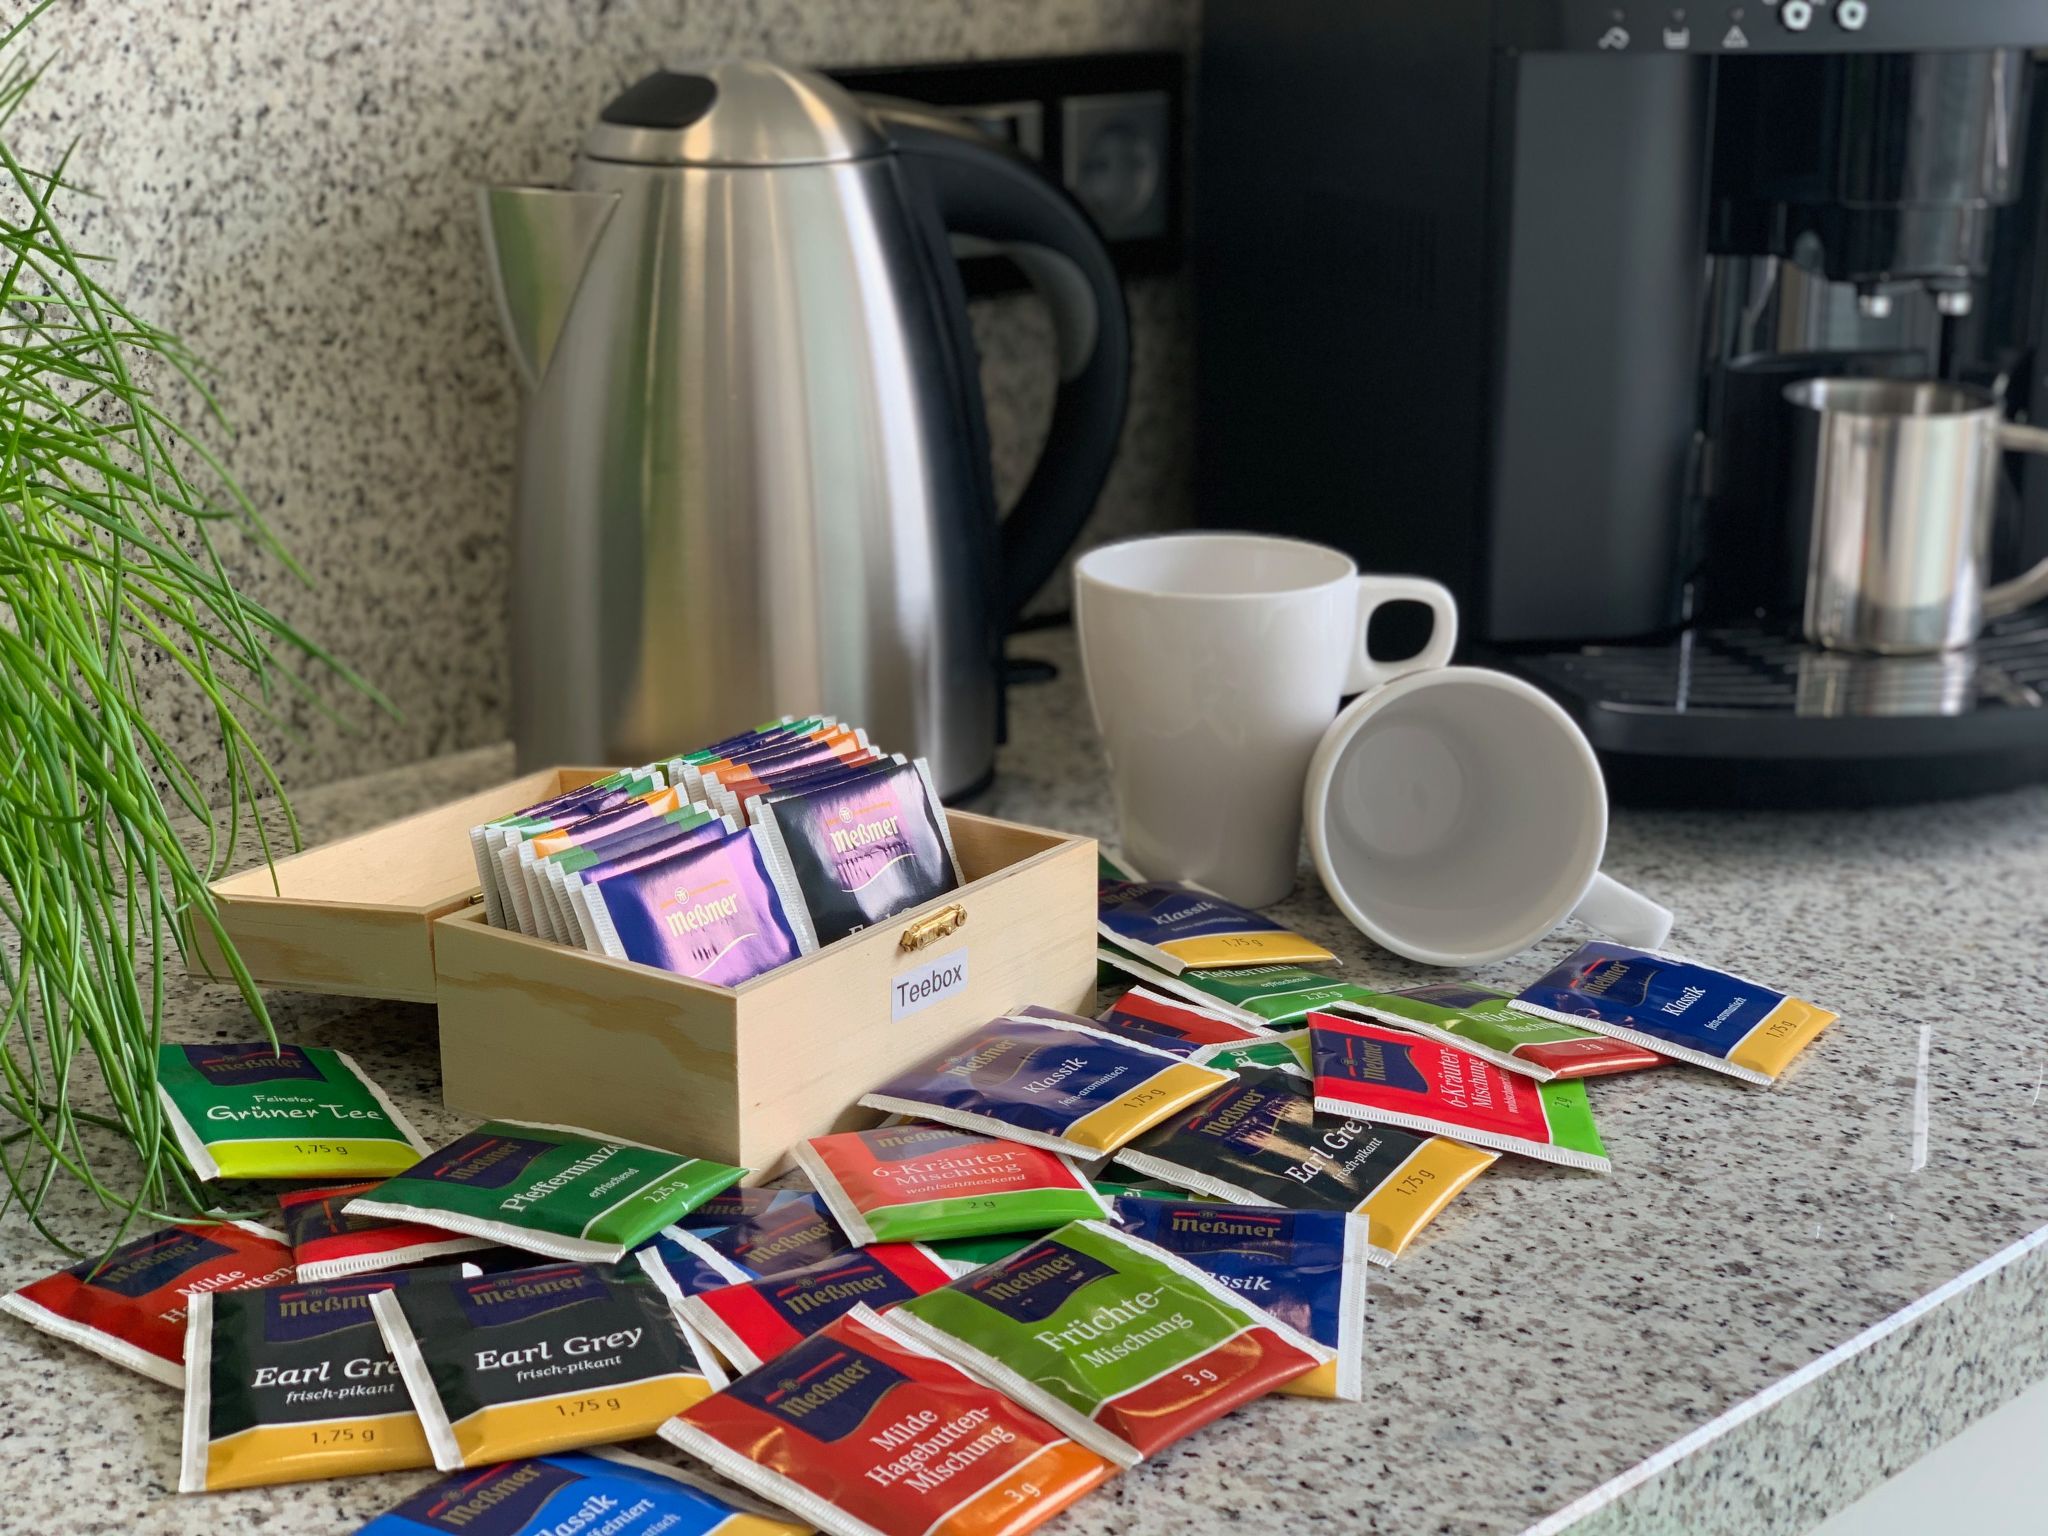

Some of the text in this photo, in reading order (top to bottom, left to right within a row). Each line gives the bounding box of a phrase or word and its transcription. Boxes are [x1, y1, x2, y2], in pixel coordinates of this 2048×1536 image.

[829, 815, 900, 854] Meßmer
[666, 891, 740, 938] Meßmer
[1152, 901, 1218, 926] Klassik
[1222, 937, 1264, 948] 1,75 g
[896, 963, 964, 1008] Teebox
[1582, 960, 1631, 996] Meßmer
[1301, 989, 1344, 1001] 2,25 g
[1661, 985, 1707, 1017] Klassik
[1703, 996, 1748, 1031] fein-aromatisch
[1766, 1020, 1799, 1040] 1,75 g
[208, 1055, 303, 1074] Meßmer
[948, 1038, 1018, 1077] Meßmer
[1363, 1040, 1387, 1082] Meßmer
[1022, 1056, 1088, 1094] Klassik
[1057, 1065, 1129, 1107] fein-aromatisch
[1439, 1047, 1469, 1109] 6-Kräuter-
[1467, 1057, 1494, 1110] Mischung
[206, 1103, 383, 1122] Grüner Tee
[252, 1094, 315, 1104] Feinster
[1123, 1088, 1168, 1111] 1,75 g
[1200, 1087, 1266, 1138] Meßmer
[294, 1144, 348, 1156] 1,75 g
[449, 1141, 523, 1181] Meßmer
[871, 1151, 1028, 1178] 6-Kräuter-
[1284, 1145, 1334, 1184] Earl
[1334, 1137, 1383, 1184] frisch-pikant
[500, 1143, 628, 1213] Pfefferminze
[588, 1167, 640, 1199] erfrischend
[895, 1163, 1023, 1186] Mischung
[905, 1174, 1027, 1195] wohlschmeckend
[1397, 1168, 1437, 1196] 1,75 g
[647, 1180, 689, 1204] 2,25 g
[967, 1200, 997, 1209] 2 g
[747, 1221, 836, 1265] Meßmer
[1172, 1217, 1281, 1238] Meßmer
[103, 1241, 200, 1284] Meßmer
[983, 1253, 1077, 1301] Meßmer
[174, 1269, 247, 1296] Milde
[470, 1275, 586, 1307] Meßmer
[783, 1273, 889, 1316] Meßmer
[279, 1295, 370, 1318] Meßm
[1033, 1286, 1165, 1352] Früchte-
[474, 1327, 644, 1371] Earl Grey
[1080, 1312, 1195, 1368] Mischung
[251, 1357, 401, 1389] Earl Gre
[515, 1355, 623, 1384] frisch-pikant
[1182, 1368, 1218, 1387] 3 g
[285, 1383, 396, 1405] frisch-pikant
[777, 1359, 872, 1419] Meßmer
[556, 1398, 622, 1417] 1,75 g
[311, 1428, 375, 1444] 1,75 g
[864, 1406, 991, 1487] Hagebutten-
[869, 1409, 939, 1452] Milde
[902, 1424, 1017, 1495] Mischung
[440, 1463, 542, 1528] Meßmer
[1004, 1481, 1042, 1504] 3 g
